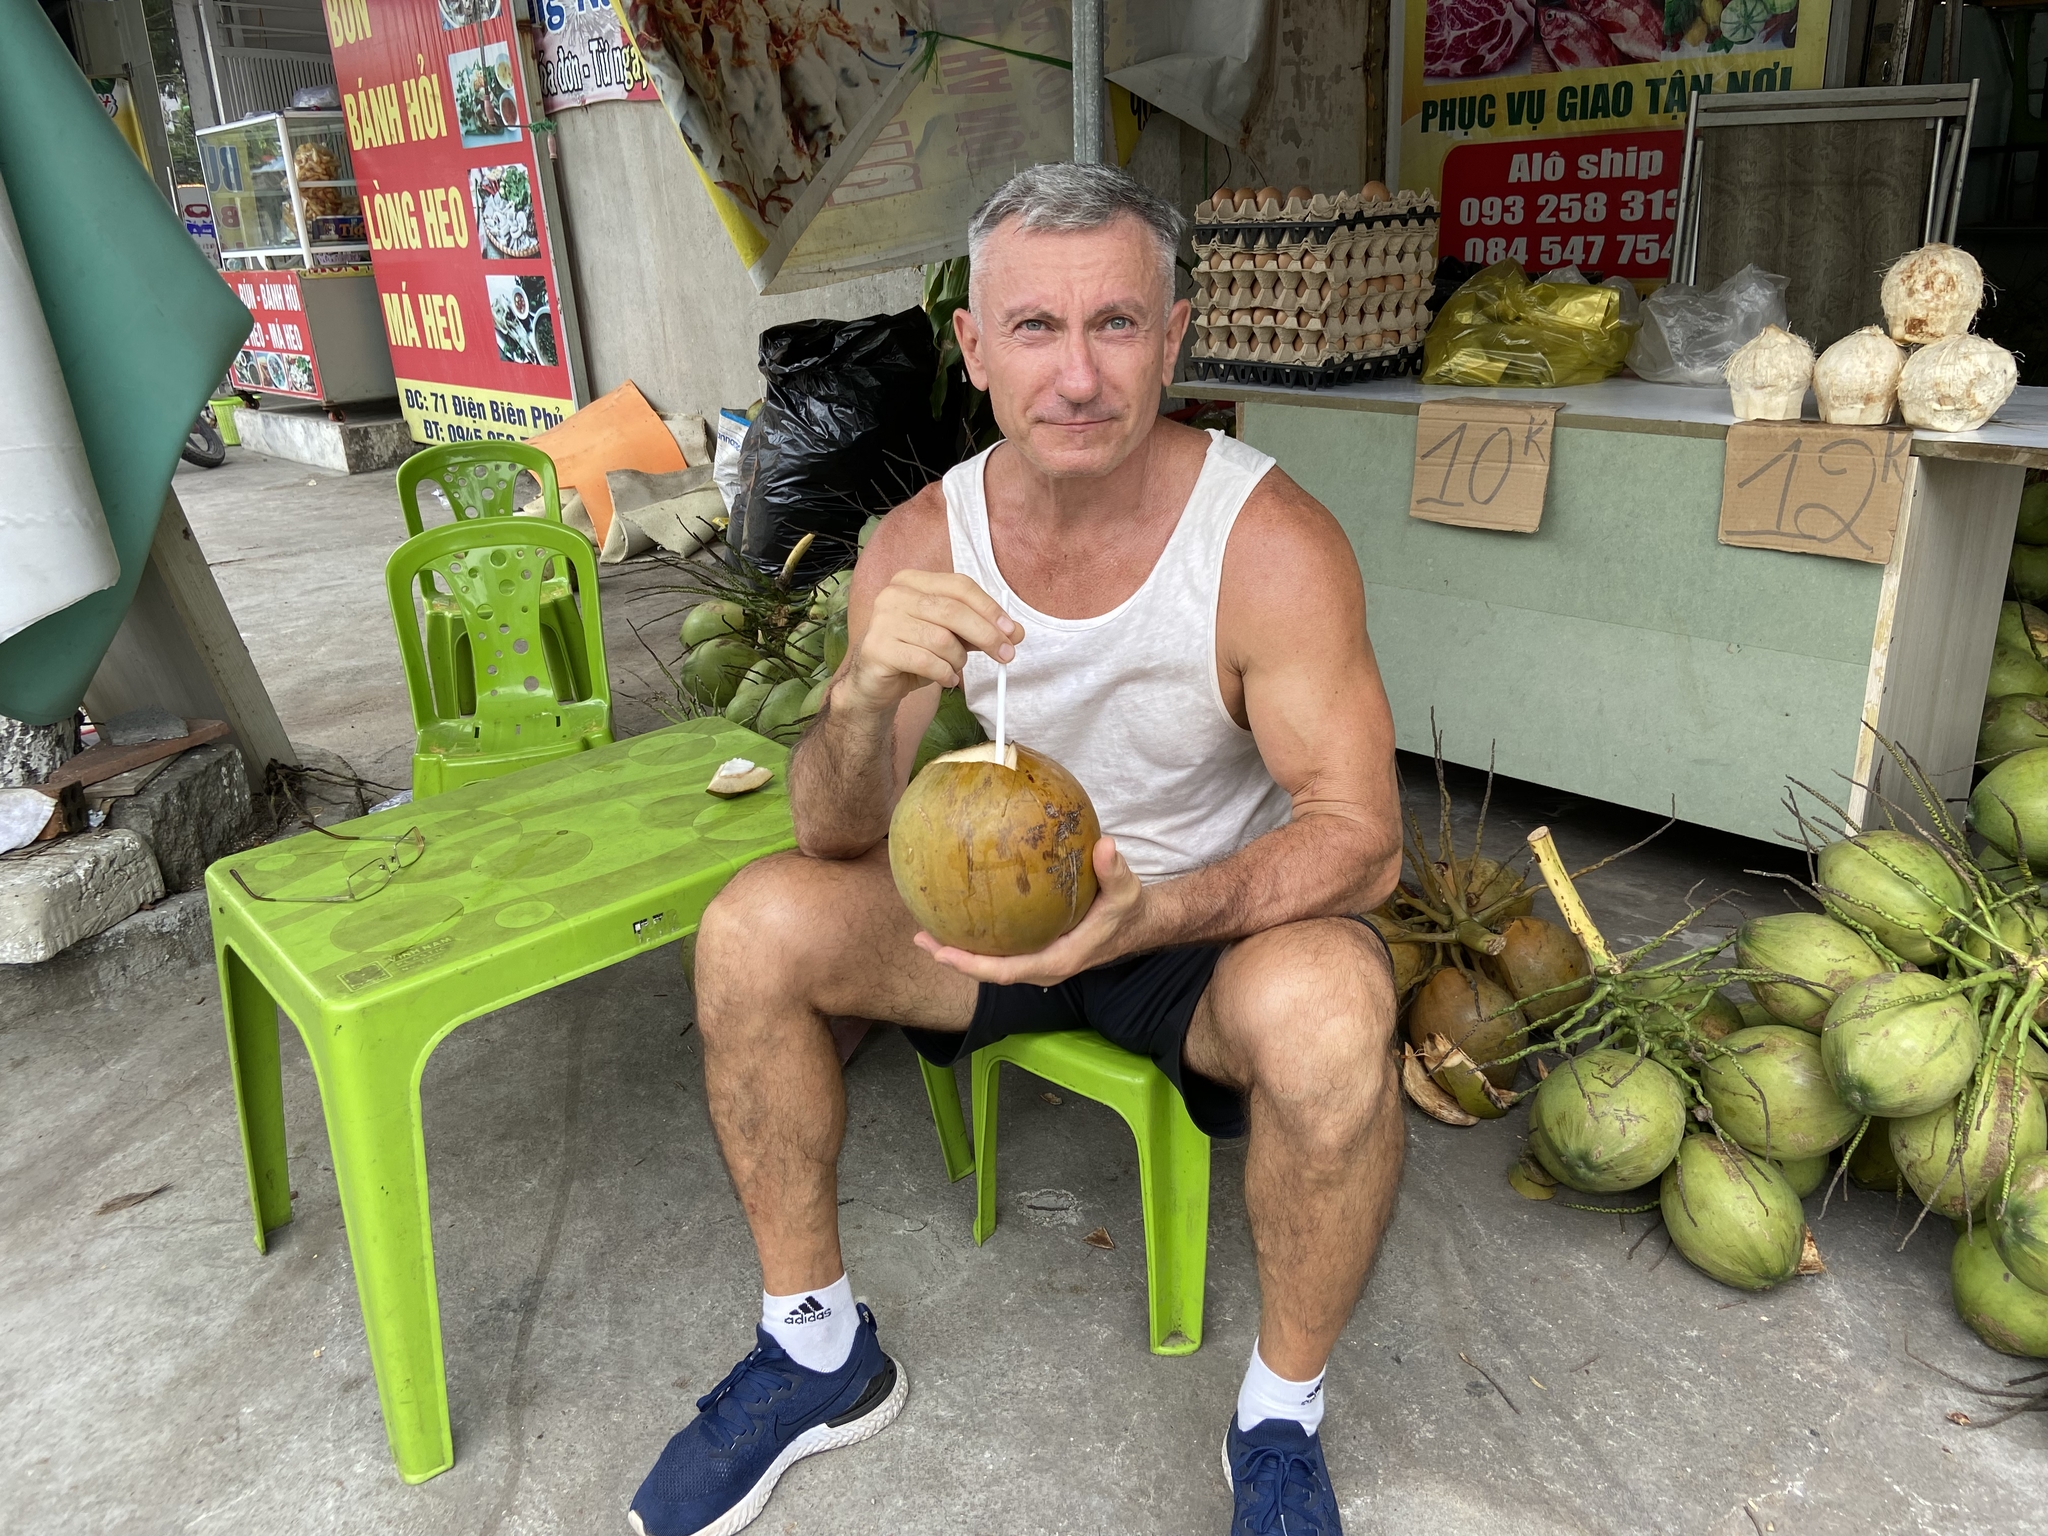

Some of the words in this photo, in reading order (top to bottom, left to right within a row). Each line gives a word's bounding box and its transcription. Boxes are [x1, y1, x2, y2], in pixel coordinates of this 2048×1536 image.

[557, 44, 583, 94] đơn
[588, 37, 612, 88] Từ
[343, 77, 405, 150] BÁNH
[402, 53, 447, 141] HỎI
[1421, 93, 1496, 136] PHỤC
[1506, 89, 1546, 131] VỤ
[1557, 80, 1633, 122] GIAO
[1508, 151, 1566, 183] Alô
[1577, 146, 1664, 180] ship
[363, 179, 422, 250] LÒNG
[419, 186, 469, 249] HEO
[1459, 195, 1525, 226] 093
[1535, 192, 1607, 224] 258
[1464, 237, 1528, 265] 084
[1539, 235, 1605, 265] 547
[260, 277, 285, 311] BÁNH
[268, 317, 286, 350] MÁ
[282, 324, 303, 351] HEO
[382, 281, 422, 348] MÁ
[418, 294, 465, 352] HEO
[405, 389, 429, 411] ĐC:
[430, 392, 447, 414] 71
[452, 395, 487, 423] Điện
[489, 400, 527, 427] Biên
[423, 419, 445, 442] ĐT:
[784, 1308, 832, 1325] adidas
